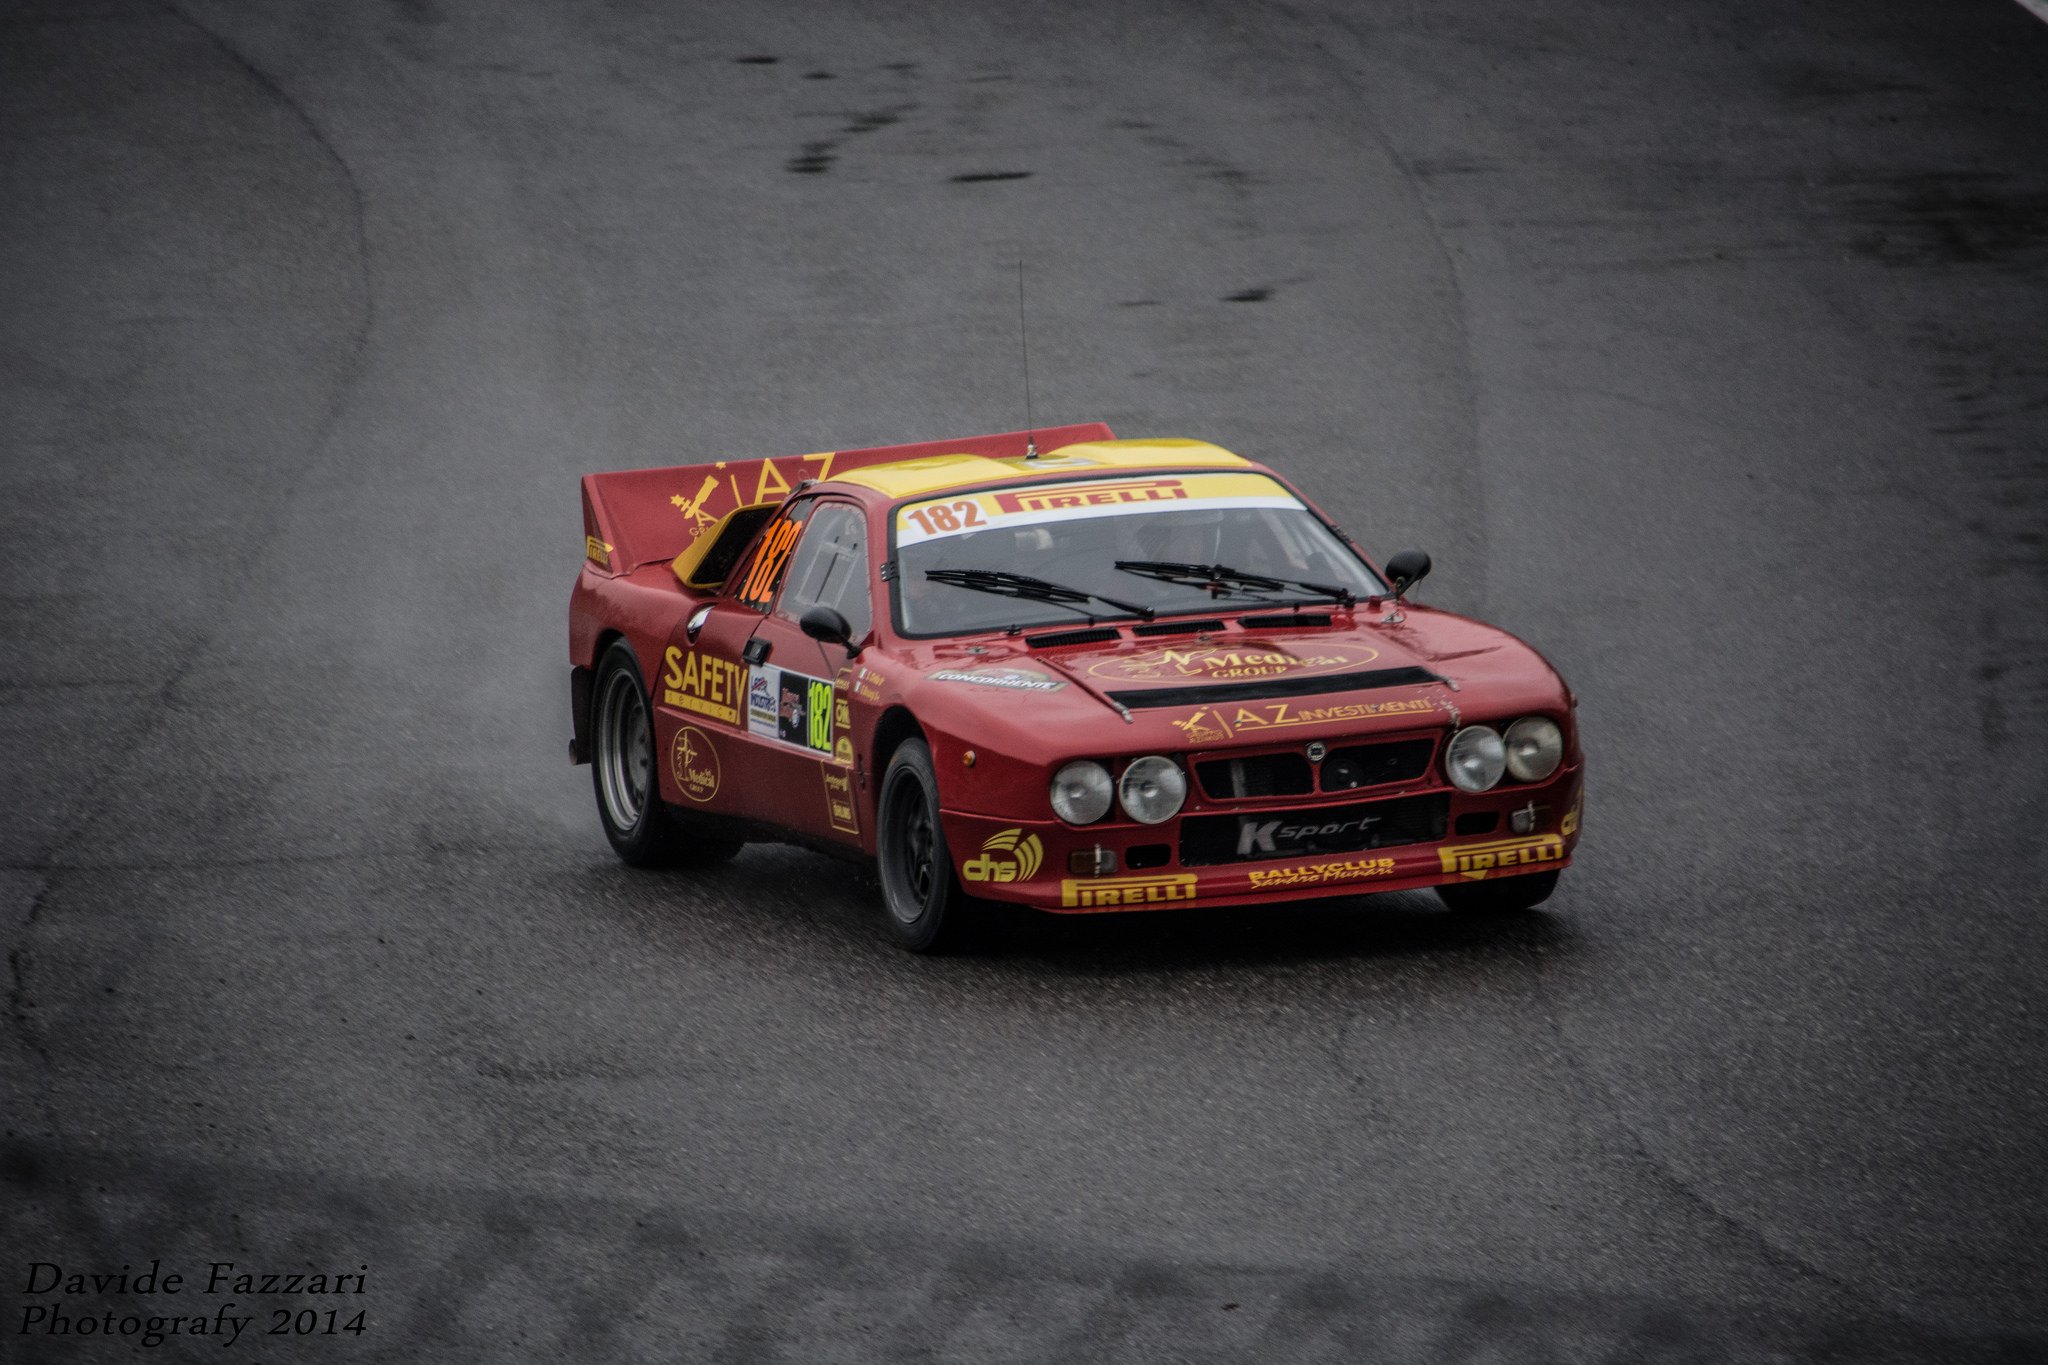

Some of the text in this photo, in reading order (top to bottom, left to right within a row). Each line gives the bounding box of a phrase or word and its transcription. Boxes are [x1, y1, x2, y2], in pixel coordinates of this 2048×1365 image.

[995, 481, 1187, 513] PIRELLI
[908, 501, 985, 533] 182
[738, 517, 804, 603] 182
[663, 645, 749, 726] SAFETY
[1211, 665, 1288, 679] GROUP
[809, 681, 832, 751] 182
[962, 853, 1018, 883] dhs
[1248, 857, 1397, 880] RALLYCLUB
[1437, 833, 1565, 873] PIRELLI
[1061, 873, 1199, 908] PIRELLI
[1251, 865, 1395, 890] Sandro Munari
